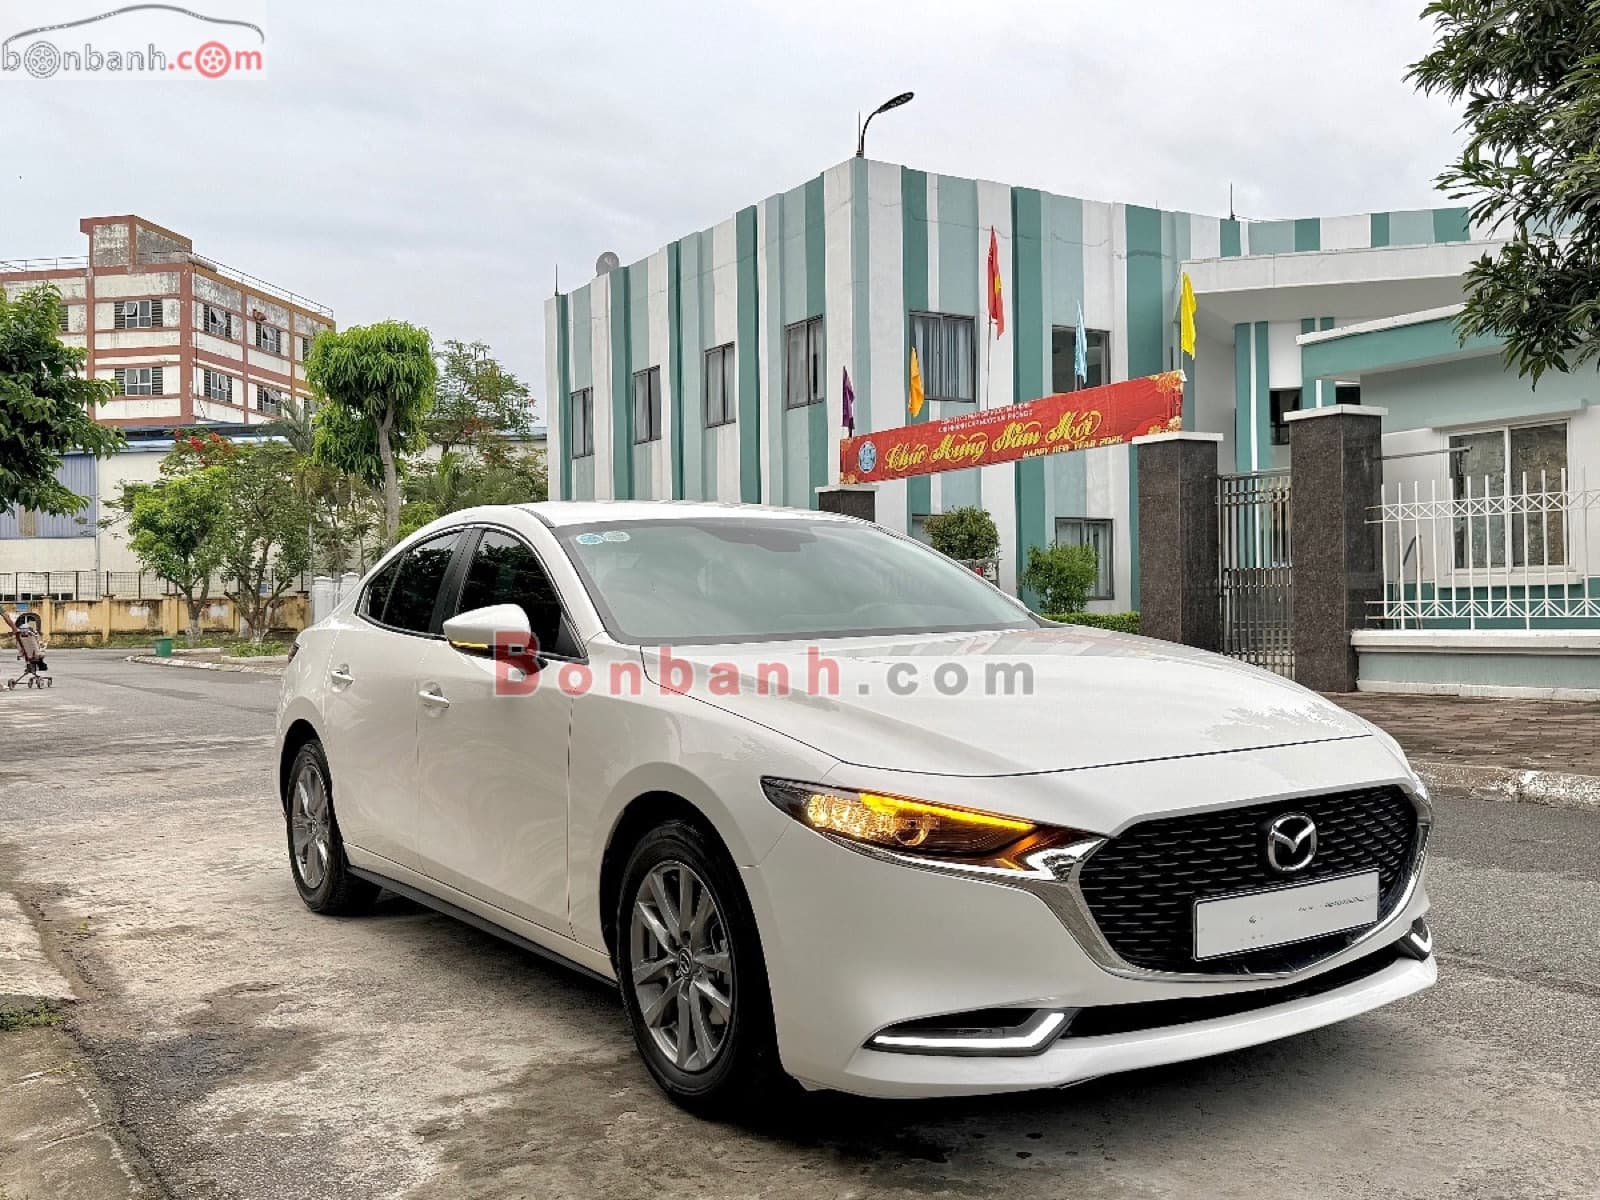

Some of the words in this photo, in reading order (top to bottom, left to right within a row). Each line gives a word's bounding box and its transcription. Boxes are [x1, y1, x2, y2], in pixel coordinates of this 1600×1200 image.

[885, 442, 929, 471] Chúc
[929, 432, 989, 464] Mừng
[992, 421, 1042, 452] Năm
[1045, 410, 1102, 443] Mới
